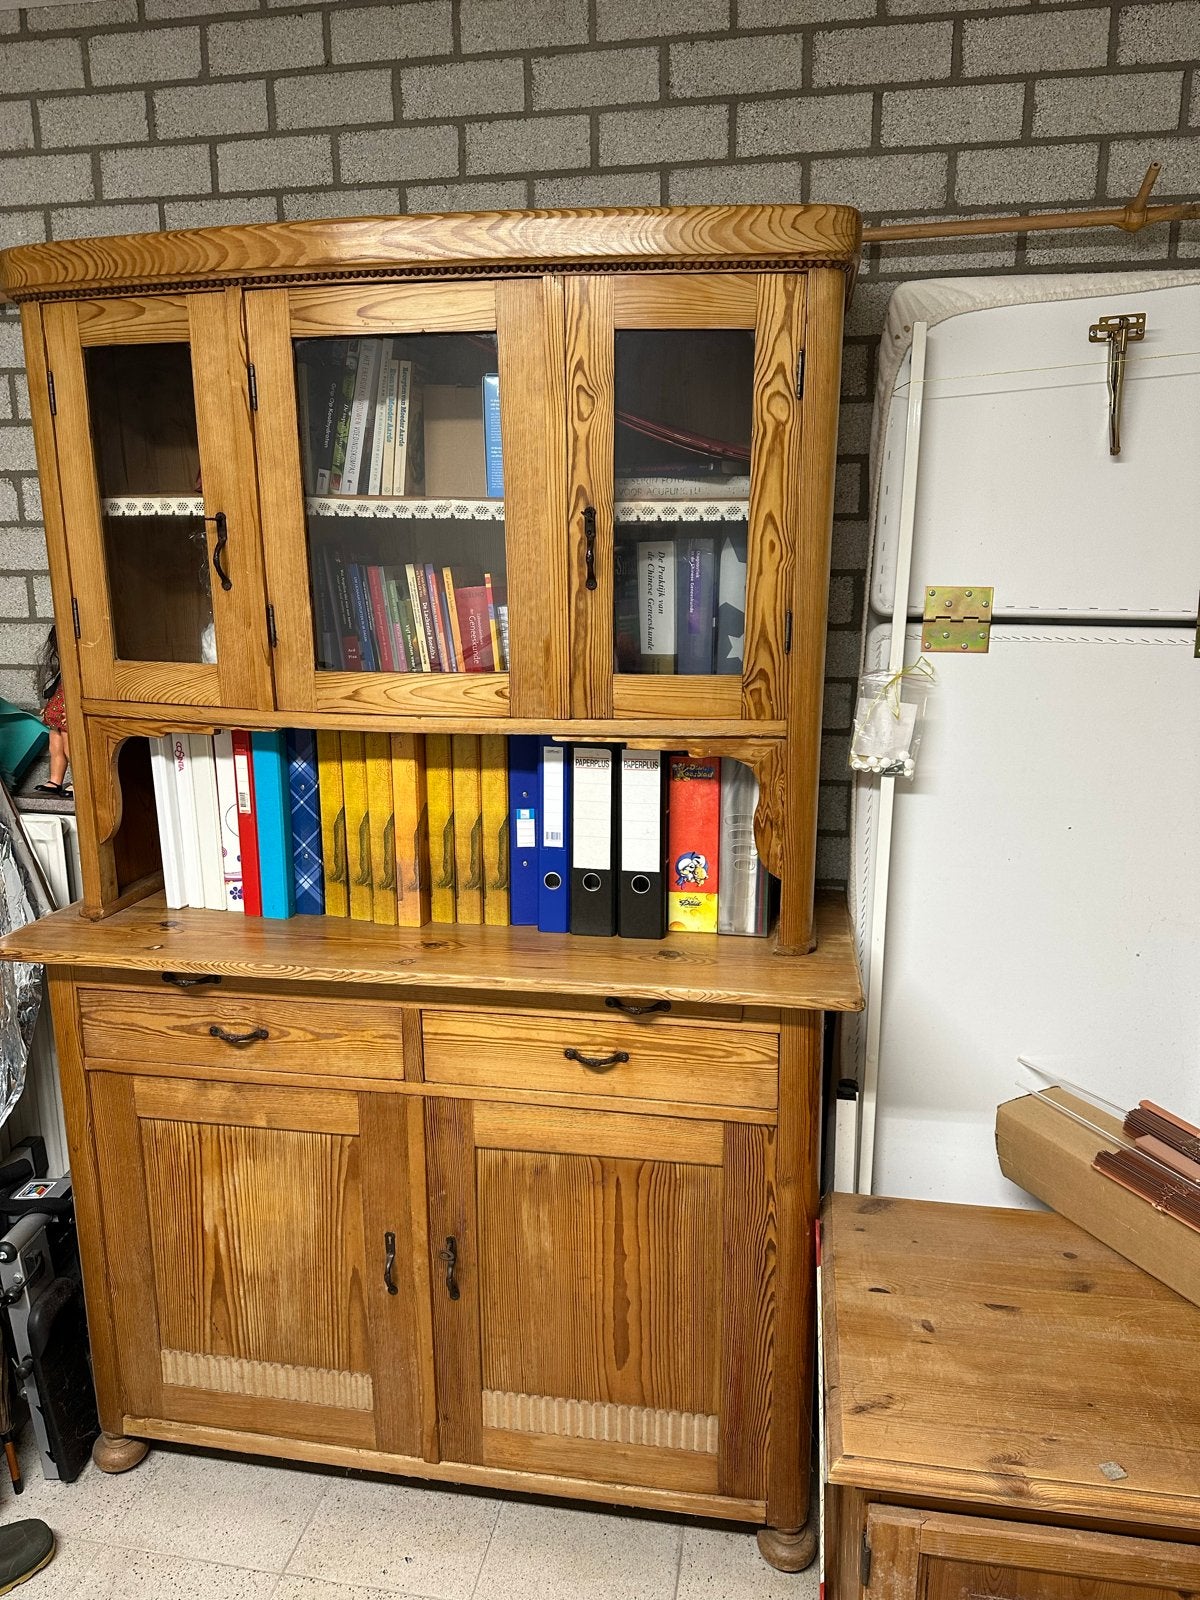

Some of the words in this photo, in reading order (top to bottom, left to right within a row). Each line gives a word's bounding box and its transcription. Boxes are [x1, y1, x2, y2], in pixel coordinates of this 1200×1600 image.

[355, 399, 365, 425] VROUWEN
[387, 399, 395, 423] Moeder
[399, 406, 407, 428] Moeder
[323, 408, 334, 448] Koolhydraten
[348, 427, 360, 475] VOEDINGSKOMPAS
[618, 488, 642, 496] VOOR
[647, 551, 655, 561] de
[658, 551, 665, 563] De
[647, 564, 655, 595] Chinese
[657, 565, 665, 597] Praktijk
[647, 598, 655, 651] Geneeskunde
[427, 636, 435, 659] Boeddha
[468, 616, 480, 664] Geneeskunde
[575, 758, 610, 768] PAPERPLUS
[624, 759, 659, 769] PAPERPLUS
